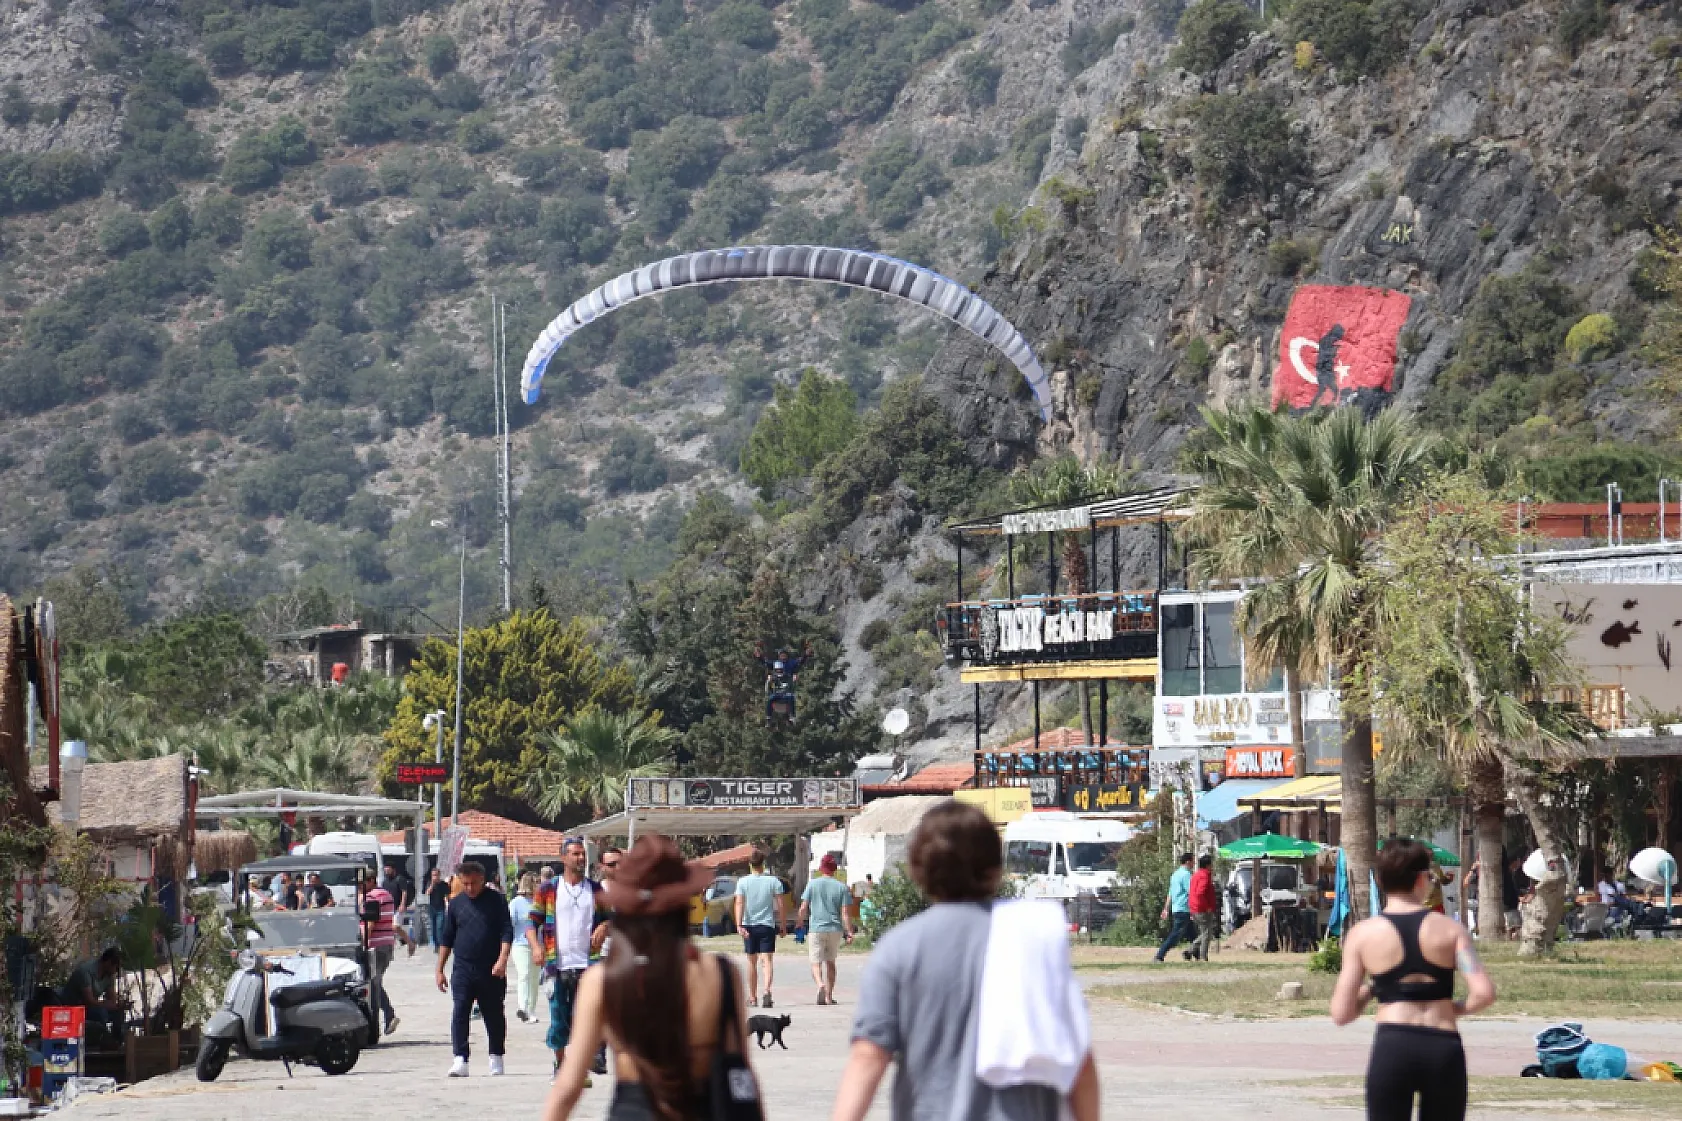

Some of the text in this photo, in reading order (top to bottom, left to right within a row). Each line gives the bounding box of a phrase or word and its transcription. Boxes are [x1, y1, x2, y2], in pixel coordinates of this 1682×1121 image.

[1381, 222, 1413, 244] JAK
[721, 781, 793, 795] TIGER
[714, 796, 770, 805] RESTAURANT
[779, 796, 797, 805] BAR
